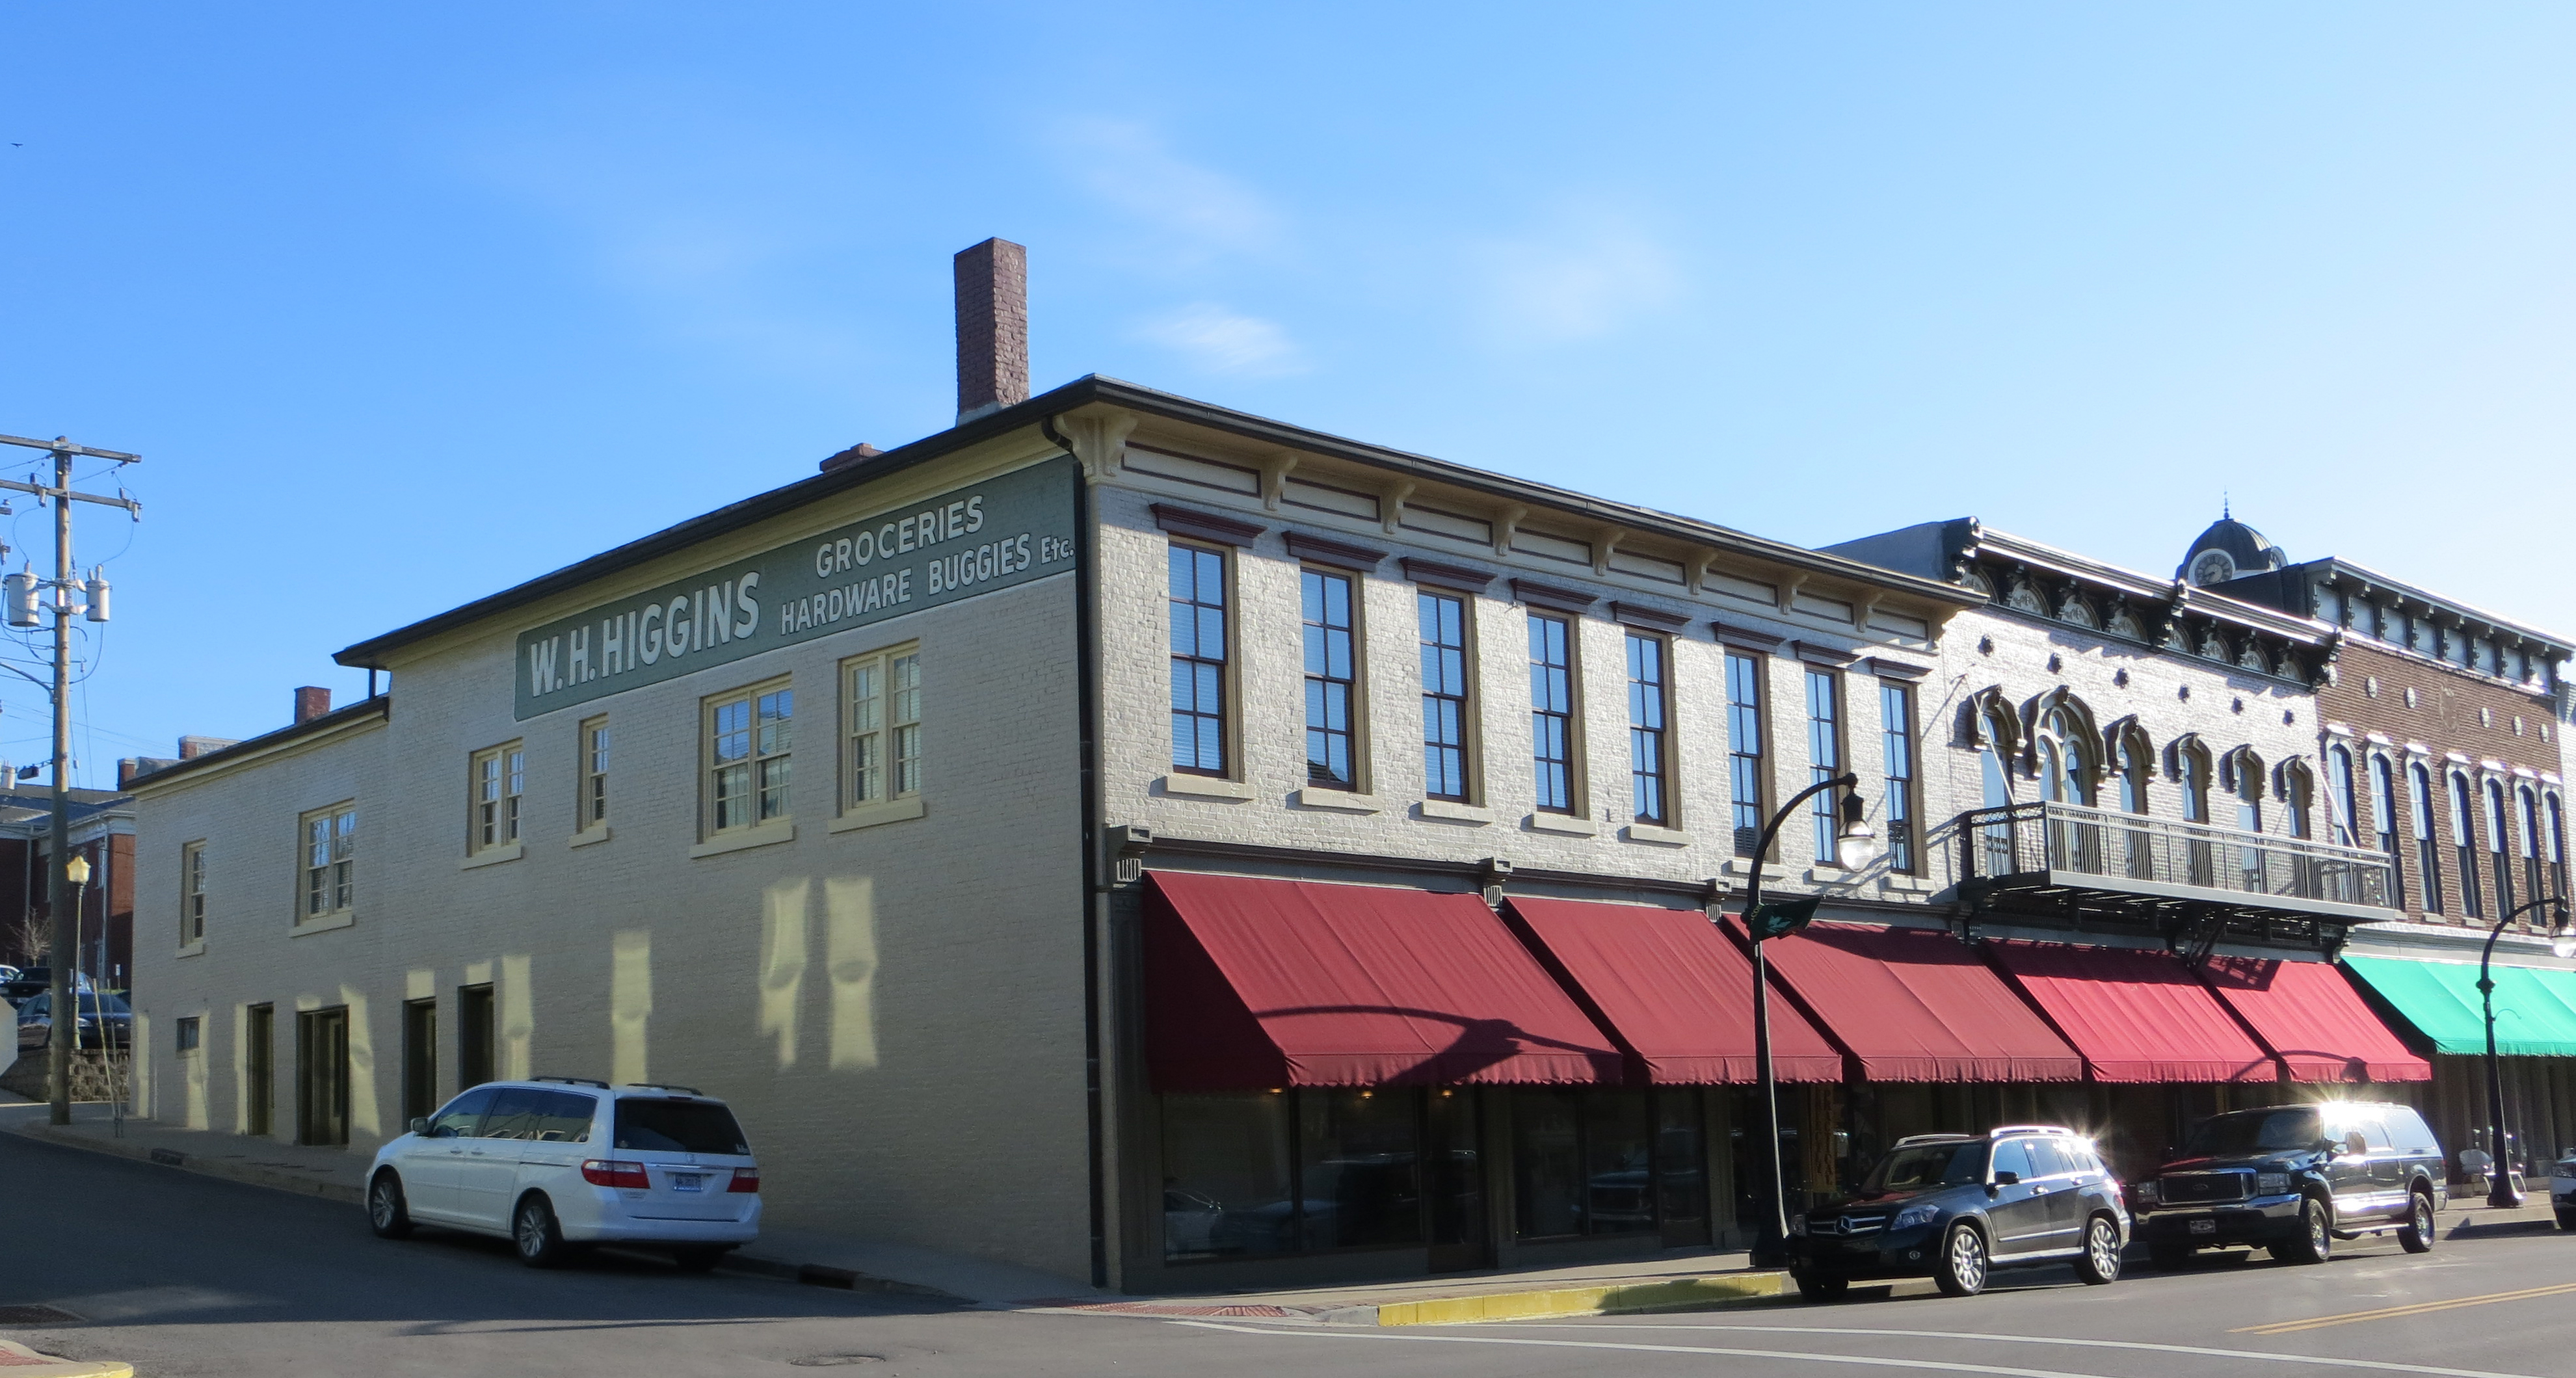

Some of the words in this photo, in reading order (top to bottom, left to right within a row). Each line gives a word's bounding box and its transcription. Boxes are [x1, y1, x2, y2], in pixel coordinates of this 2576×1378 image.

[780, 567, 912, 636] HARDWARE
[929, 533, 1031, 596] BUGGIES
[1041, 536, 1074, 564] Etc.
[816, 495, 985, 579] GROCERIES
[602, 571, 760, 678] HIGGINS
